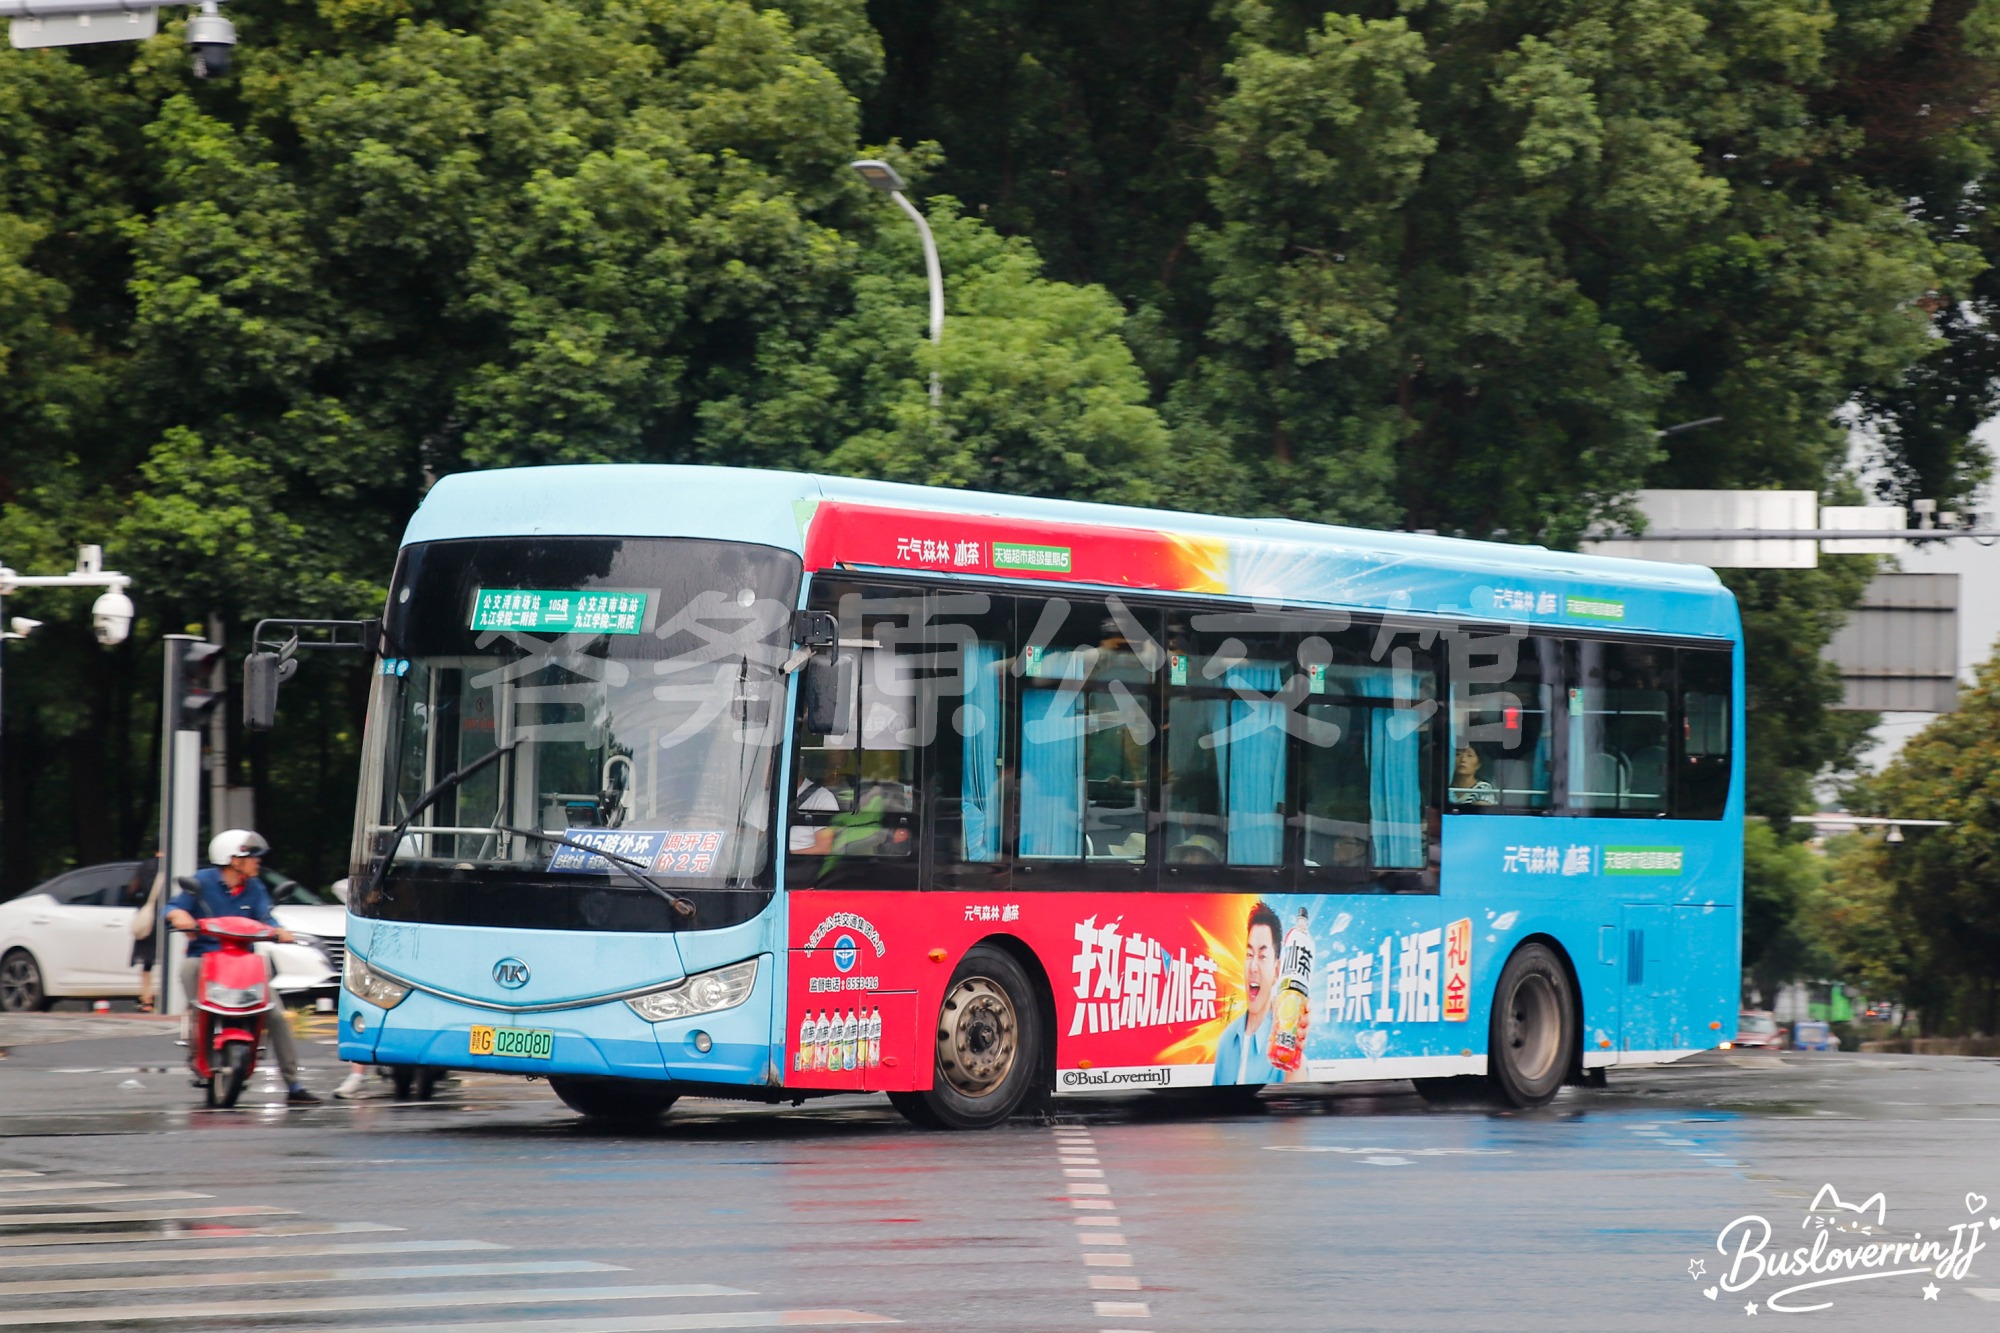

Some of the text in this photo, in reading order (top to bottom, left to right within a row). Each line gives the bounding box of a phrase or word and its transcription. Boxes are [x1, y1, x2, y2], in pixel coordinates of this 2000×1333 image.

[896, 537, 1069, 568] 元气森林 冰茶 天猫超市超级星期5
[1502, 845, 1560, 874] 元气森林
[964, 904, 1000, 922] 元气森林
[1068, 914, 1218, 1036] 热就冰茶
[1325, 928, 1442, 1023] 再来1瓶
[1447, 927, 1467, 1014] 礼金
